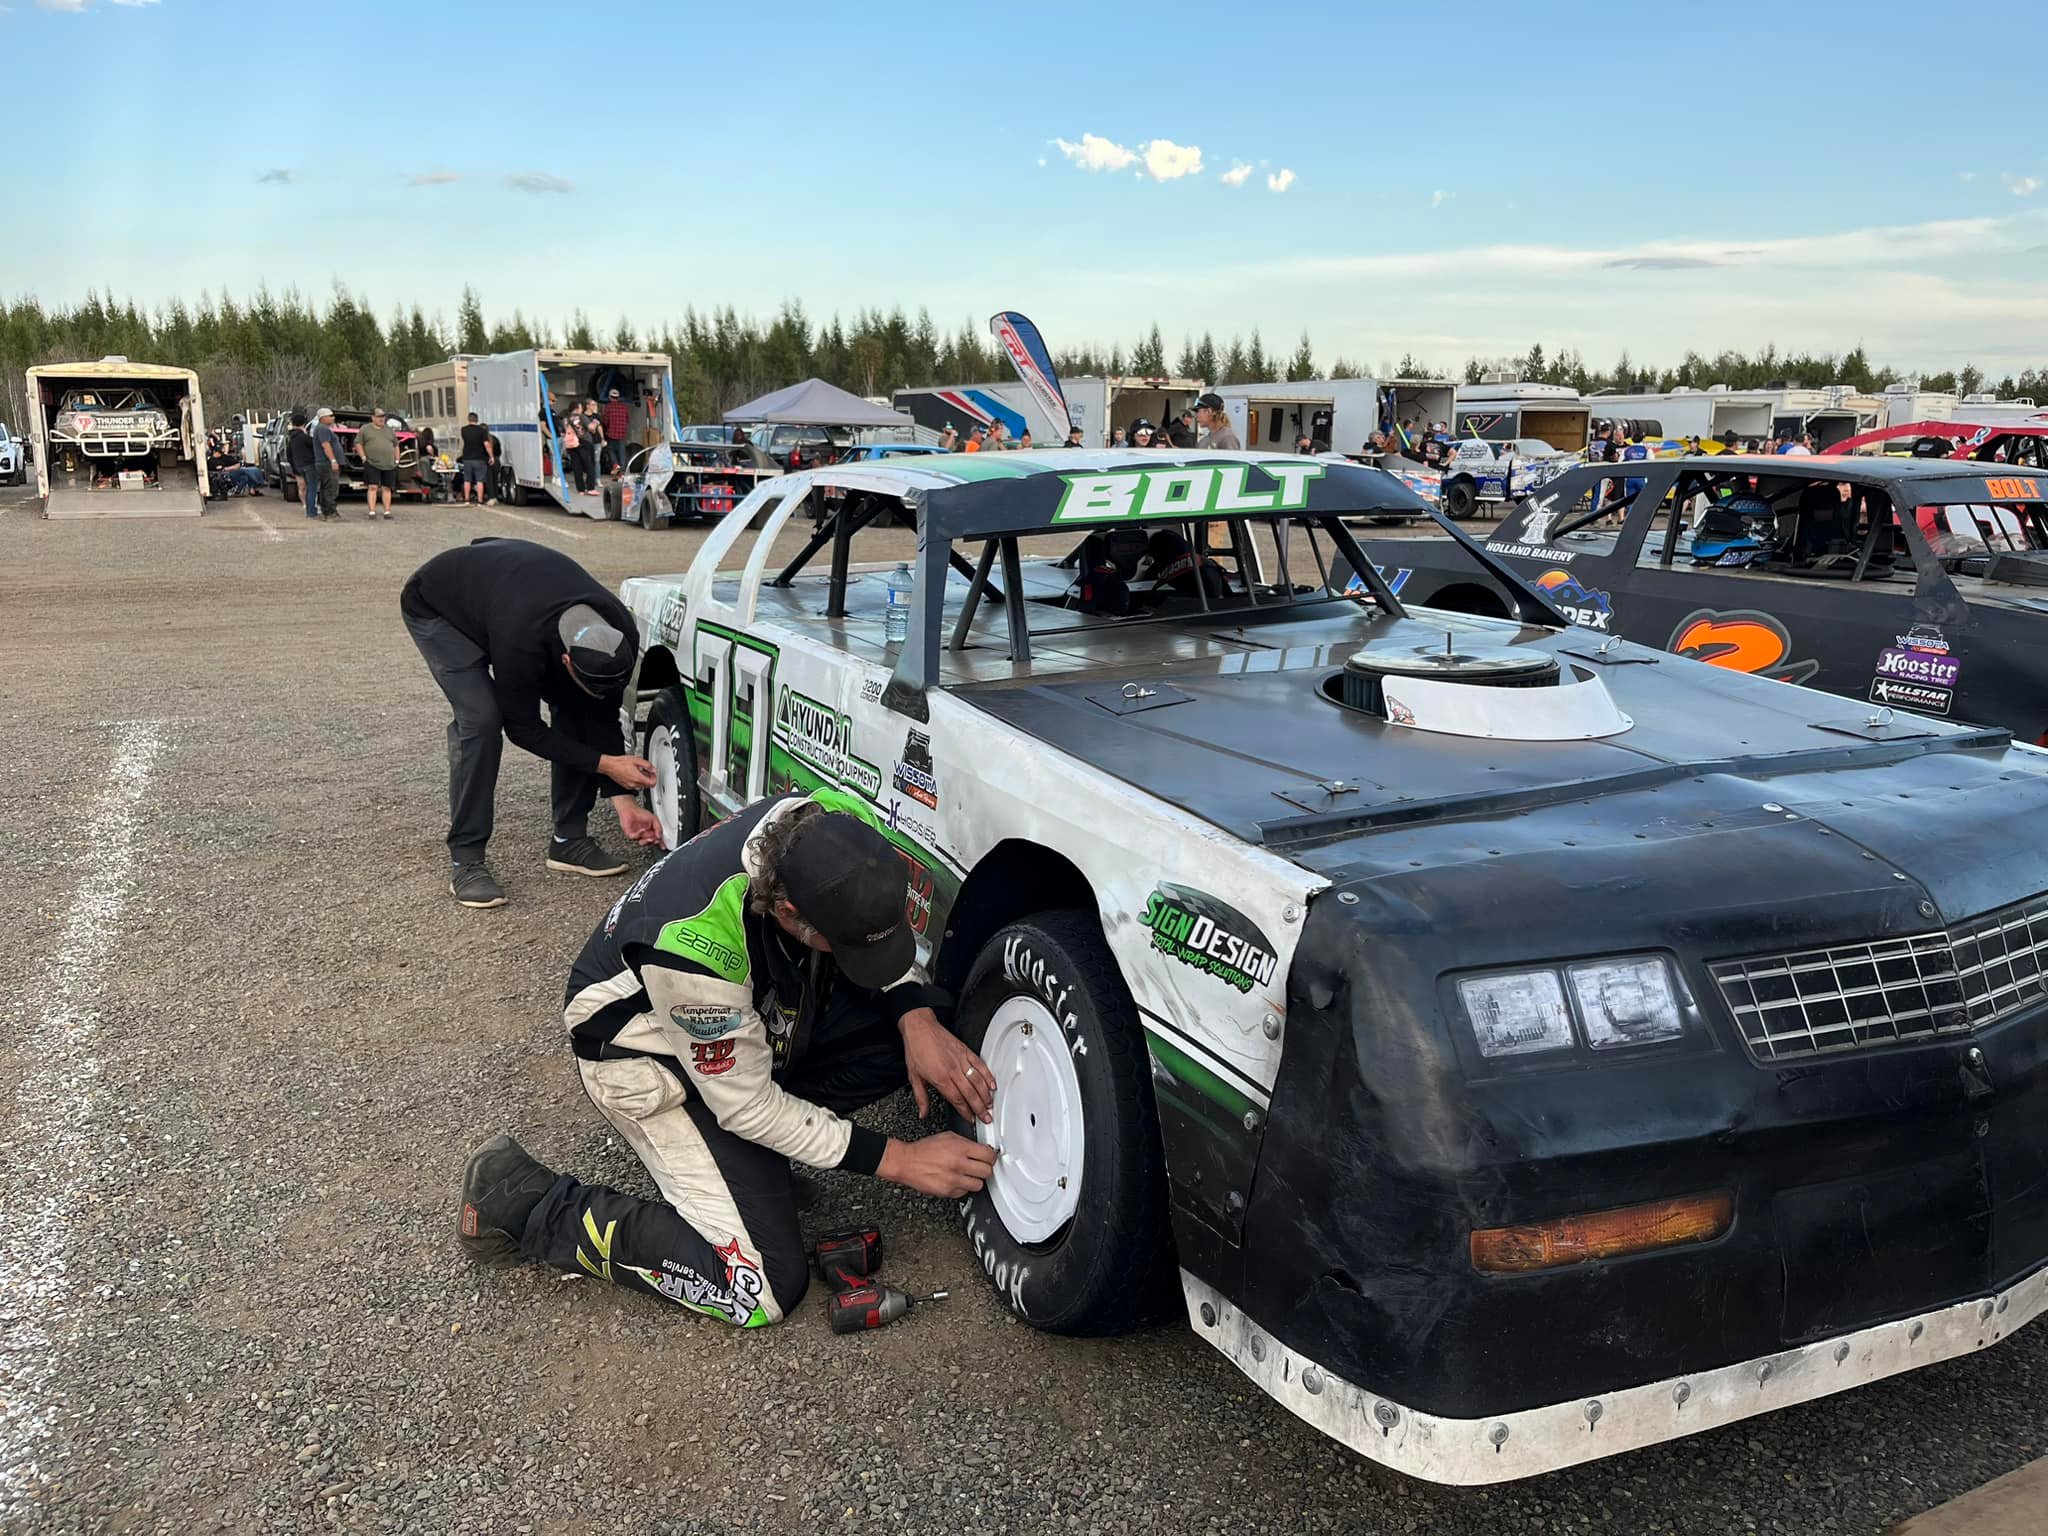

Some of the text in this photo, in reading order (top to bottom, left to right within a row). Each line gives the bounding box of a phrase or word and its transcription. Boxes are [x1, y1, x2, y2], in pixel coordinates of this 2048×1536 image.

[96, 417, 135, 425] THUNDER
[1053, 464, 1324, 521] BOLT
[1985, 479, 2041, 499] BOLT
[1485, 542, 1576, 562] HOLLAND BAKERY
[1896, 635, 1950, 650] WISSOTA
[1879, 653, 1957, 678] Hoosier
[1899, 672, 1928, 681] RACING
[862, 678, 882, 696] 3200
[1888, 684, 1948, 701] ALLSTAR
[1887, 692, 1946, 708] PERFORMANCE
[791, 702, 849, 758] HYUNDAI
[788, 730, 835, 769] CONSTRUCTION
[893, 759, 938, 797] WISSOTA
[676, 927, 744, 971] zamp
[1152, 932, 1254, 991] TOTAL WRAP SOLUTIONS
[1003, 936, 1088, 1060] Hoosier
[689, 1015, 728, 1025] WATER
[688, 1024, 729, 1037] Haulage
[690, 1038, 736, 1062] TB
[661, 1258, 695, 1279] Service
